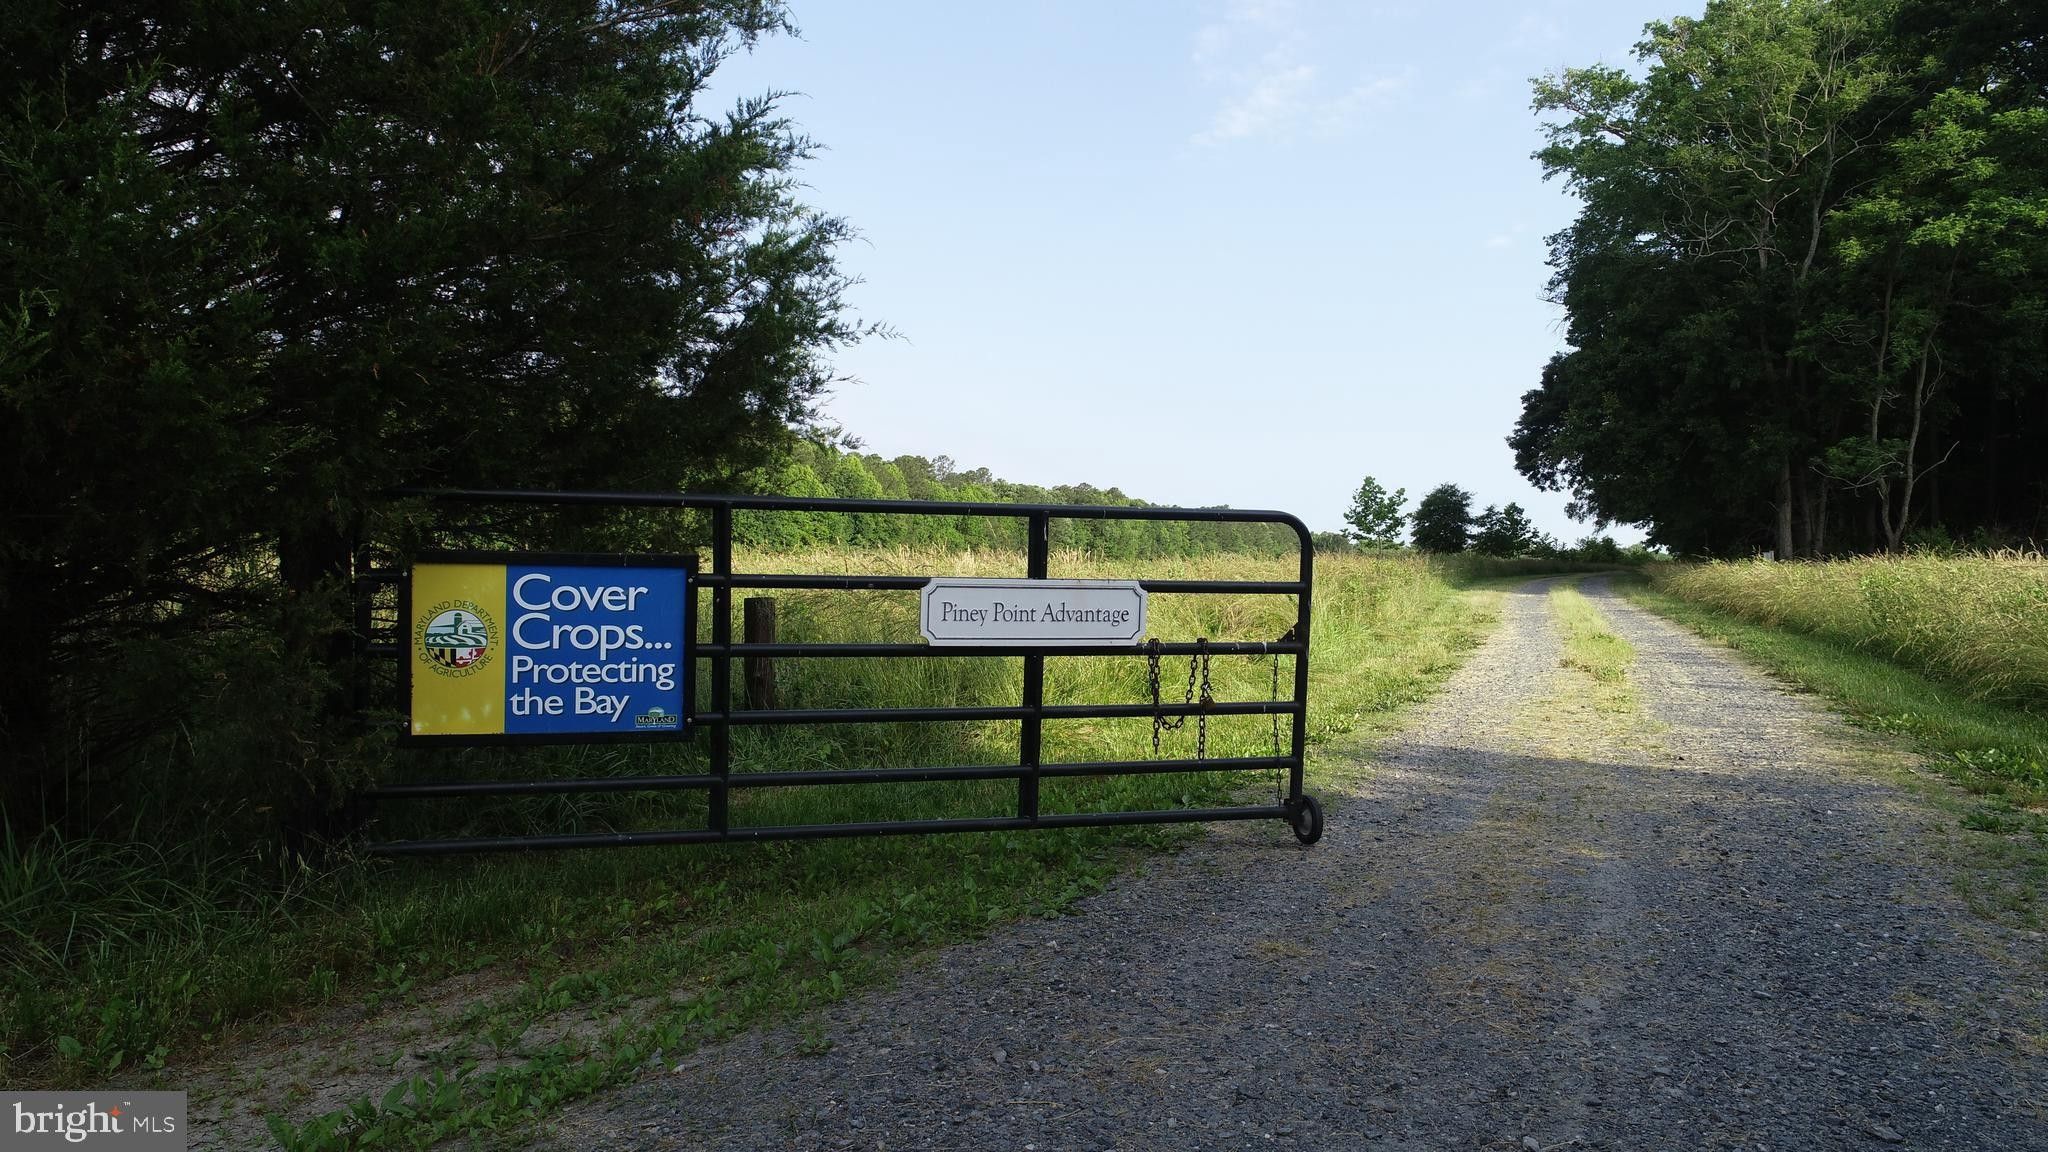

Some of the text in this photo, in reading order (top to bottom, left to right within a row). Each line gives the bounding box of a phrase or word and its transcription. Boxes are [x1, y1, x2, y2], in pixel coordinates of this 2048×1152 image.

[512, 573, 649, 612] Cover
[414, 599, 499, 647] MARYLAND DEPARTMENT
[941, 601, 1130, 627] Piney Point Advantage
[512, 612, 672, 661] Crops...
[418, 652, 494, 679] OF AGRICULTURE
[512, 655, 676, 691] Protecting
[510, 686, 630, 723] the Bay
